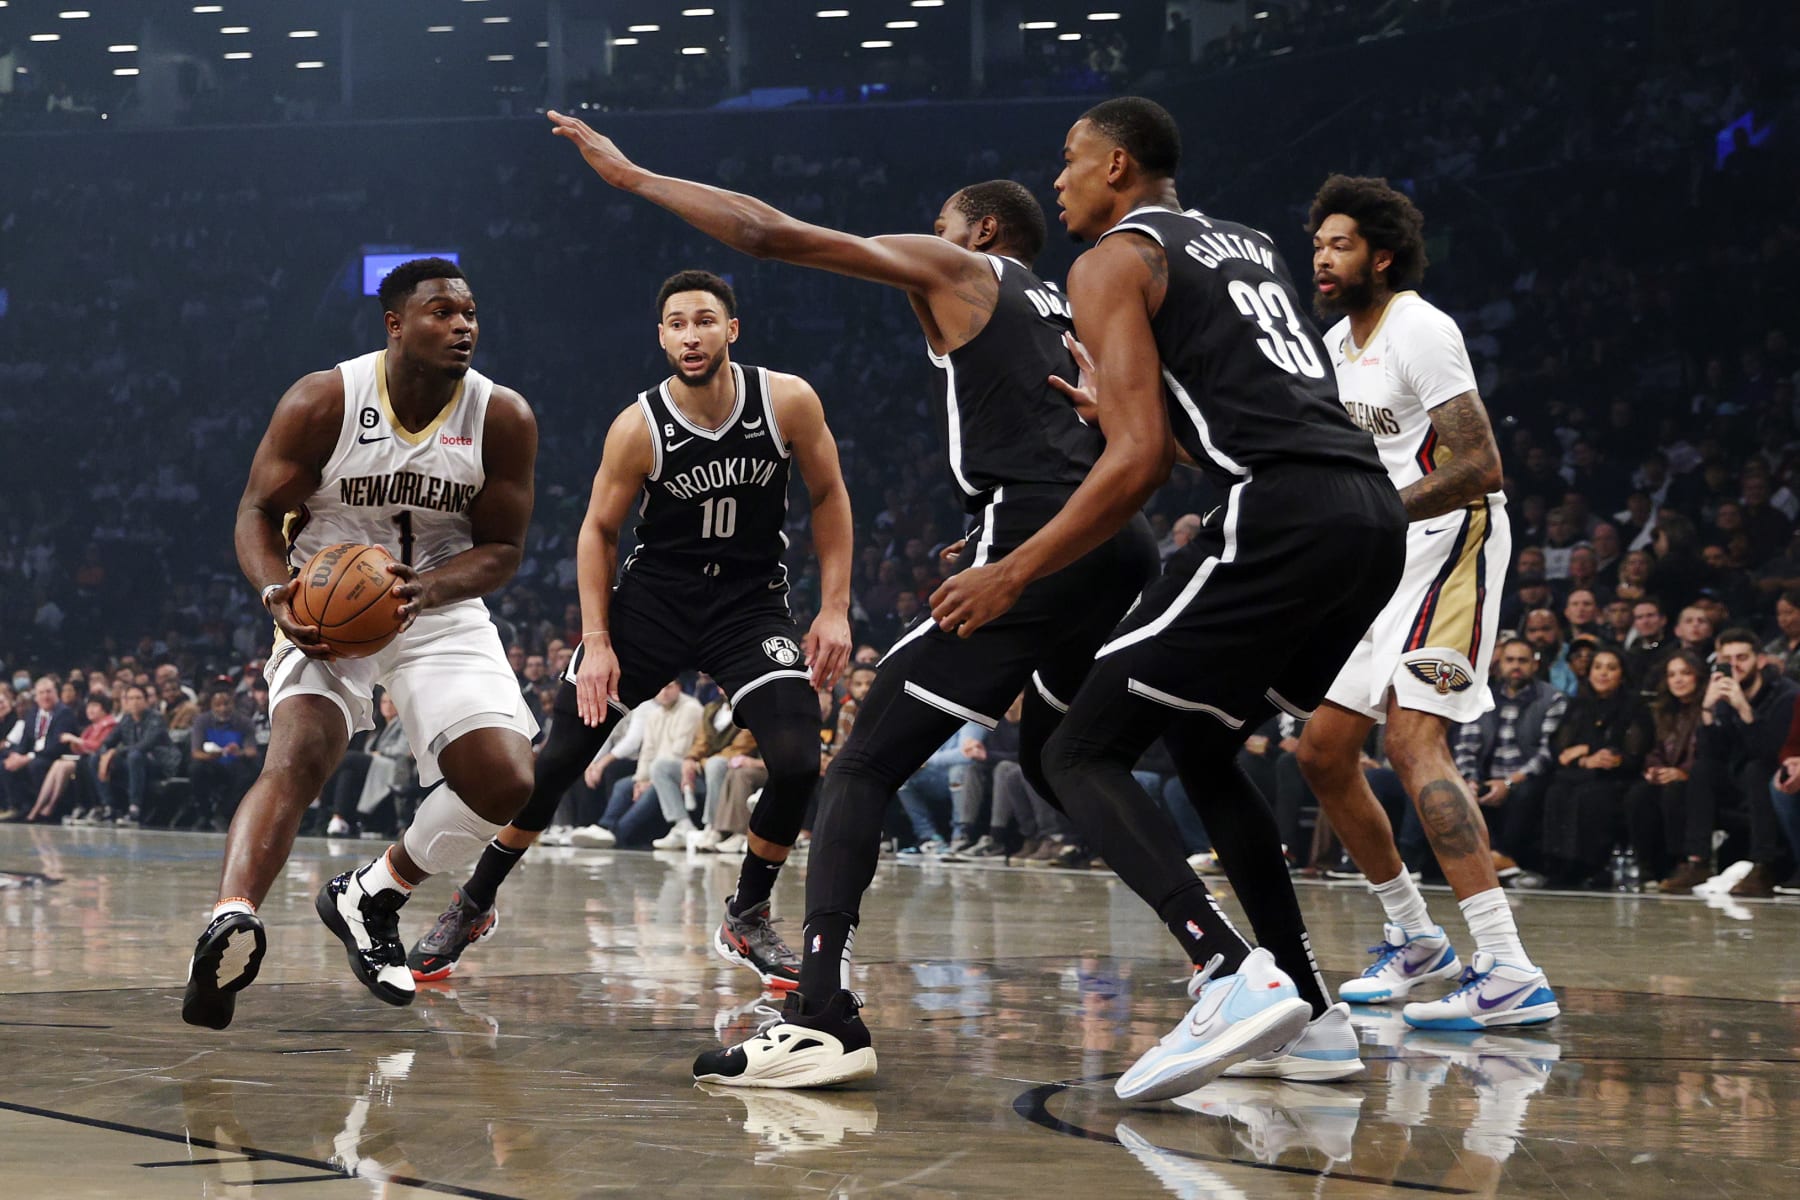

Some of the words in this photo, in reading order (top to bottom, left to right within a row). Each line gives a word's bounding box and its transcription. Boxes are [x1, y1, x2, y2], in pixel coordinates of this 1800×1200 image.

[1184, 231, 1275, 274] CLAXTON
[1227, 280, 1325, 378] 33
[363, 409, 375, 427] 6
[664, 424, 675, 437] 6
[439, 434, 472, 446] ibotta
[340, 473, 393, 507] NEW
[389, 471, 475, 513] ORLEANS
[663, 457, 778, 500] BROOKLYN
[391, 510, 416, 567] 1
[699, 497, 737, 539] 10
